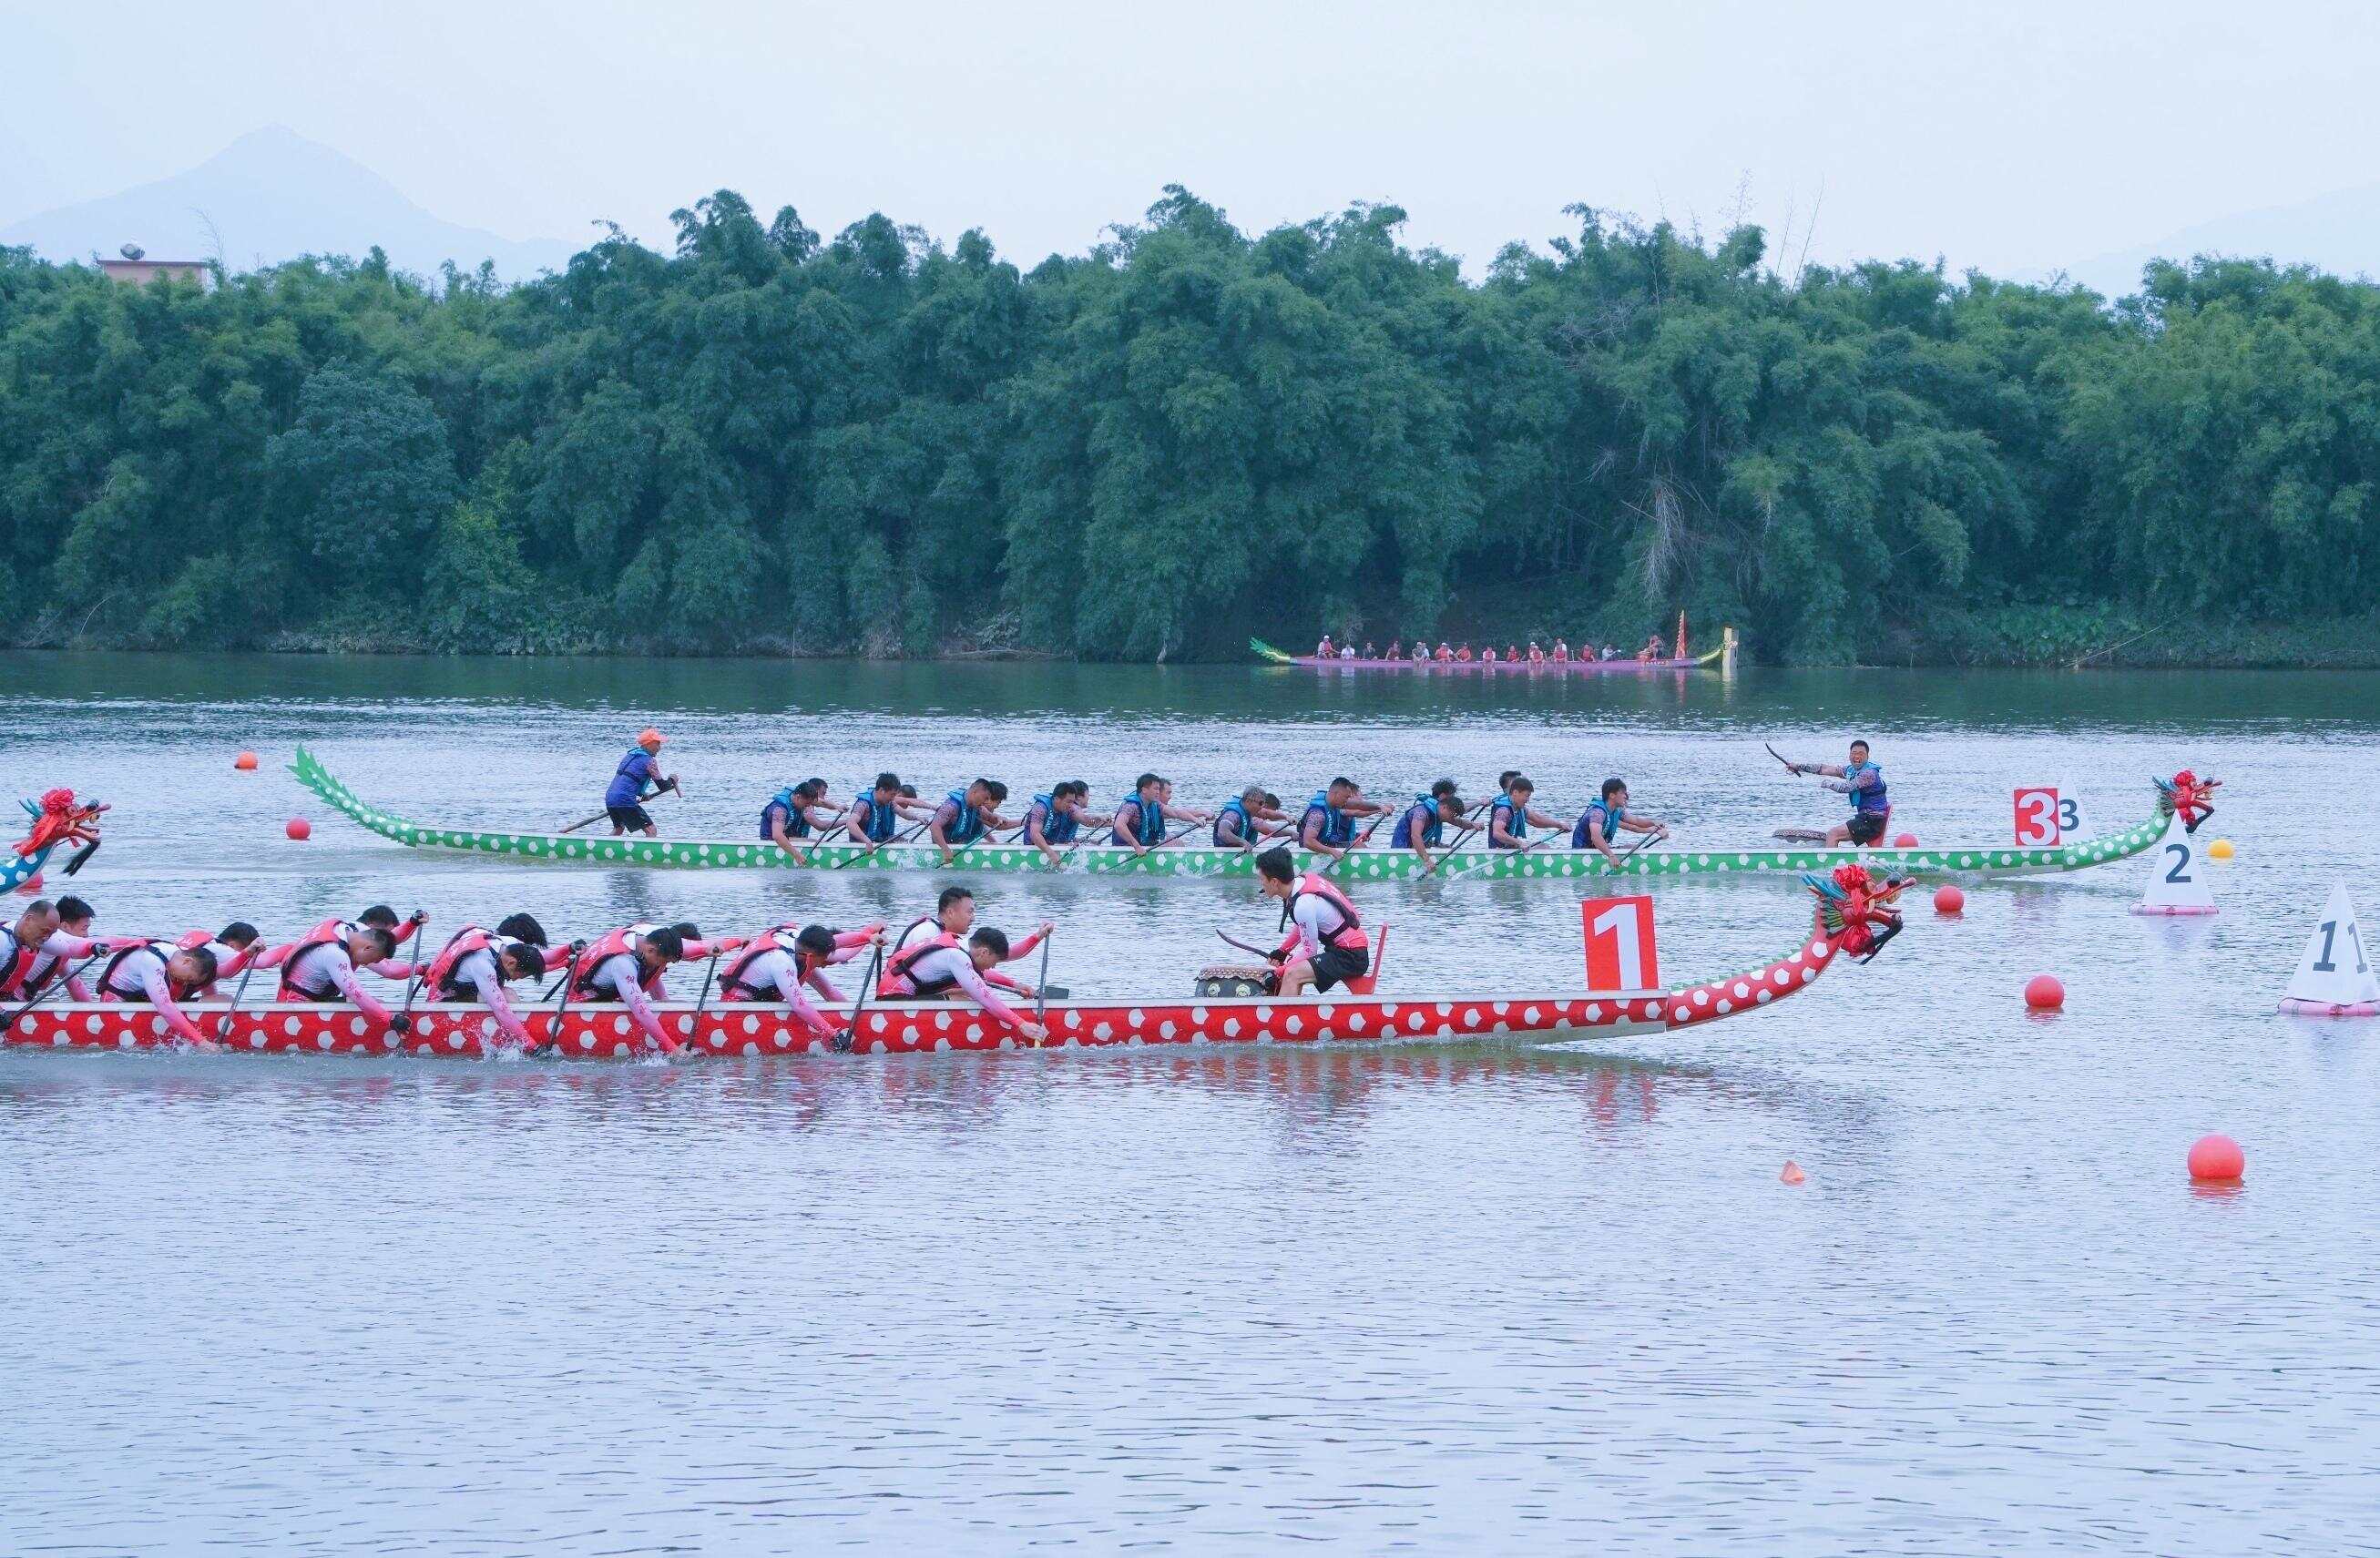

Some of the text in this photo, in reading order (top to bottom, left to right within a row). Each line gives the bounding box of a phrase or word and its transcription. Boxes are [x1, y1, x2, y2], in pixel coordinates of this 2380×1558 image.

[2017, 791, 2058, 847] 3
[2058, 799, 2079, 831] 3
[2165, 843, 2191, 884] 2
[1594, 903, 1643, 991] 1
[2312, 920, 2337, 972] 1
[2347, 922, 2368, 974] 1
